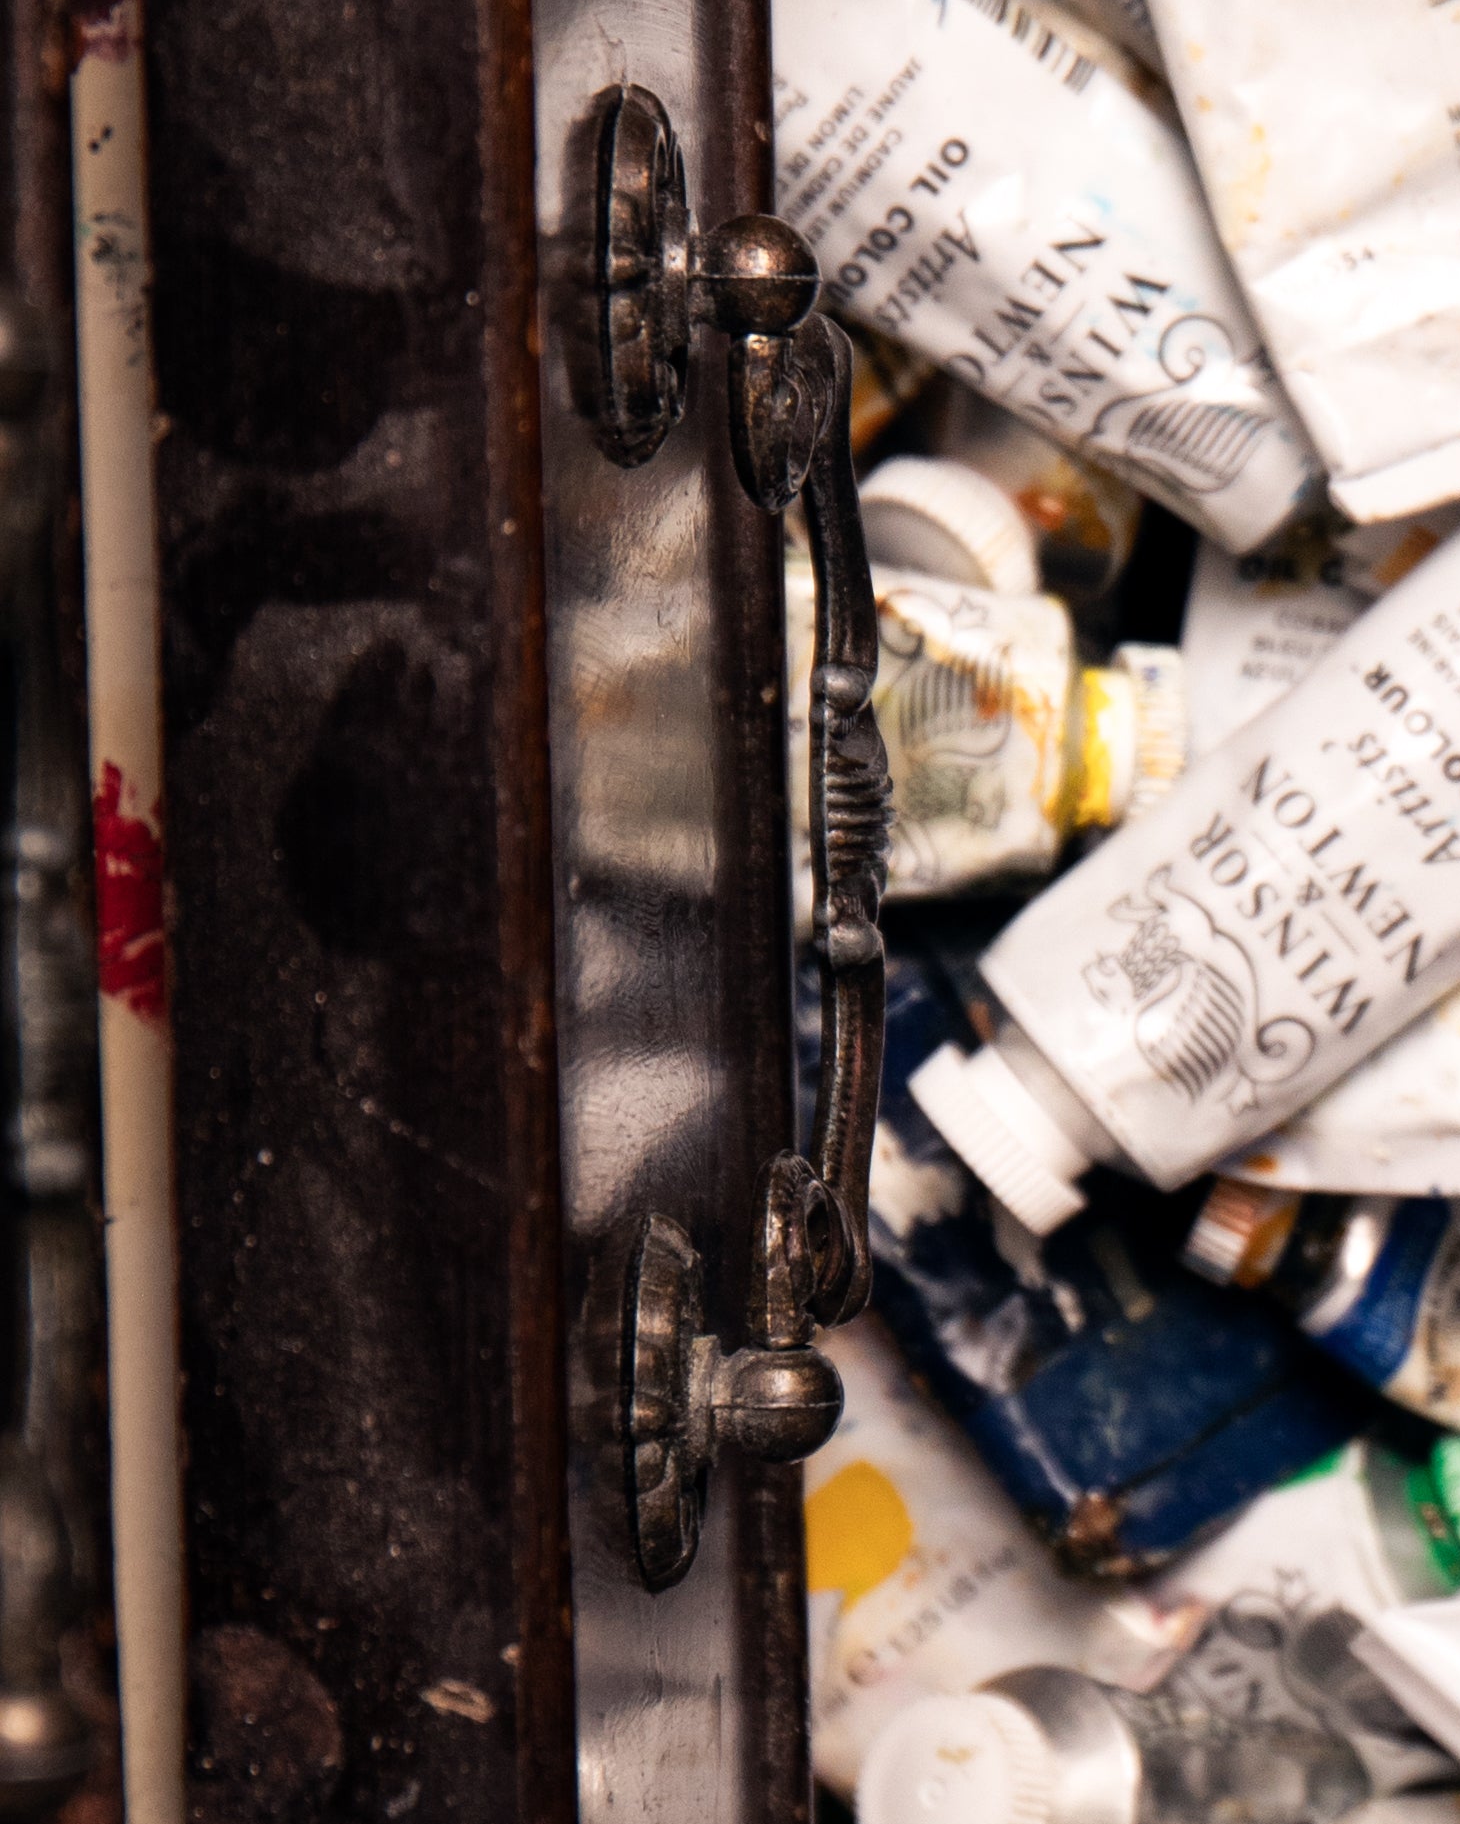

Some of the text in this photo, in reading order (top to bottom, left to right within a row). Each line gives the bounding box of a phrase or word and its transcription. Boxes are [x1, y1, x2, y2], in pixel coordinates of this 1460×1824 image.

[843, 126, 868, 155] DE
[911, 139, 968, 194] OIL
[1023, 340, 1052, 366] &
[1231, 746, 1448, 985] NEWTON
[1297, 878, 1324, 906] &
[1178, 810, 1385, 1036] WINSOR
